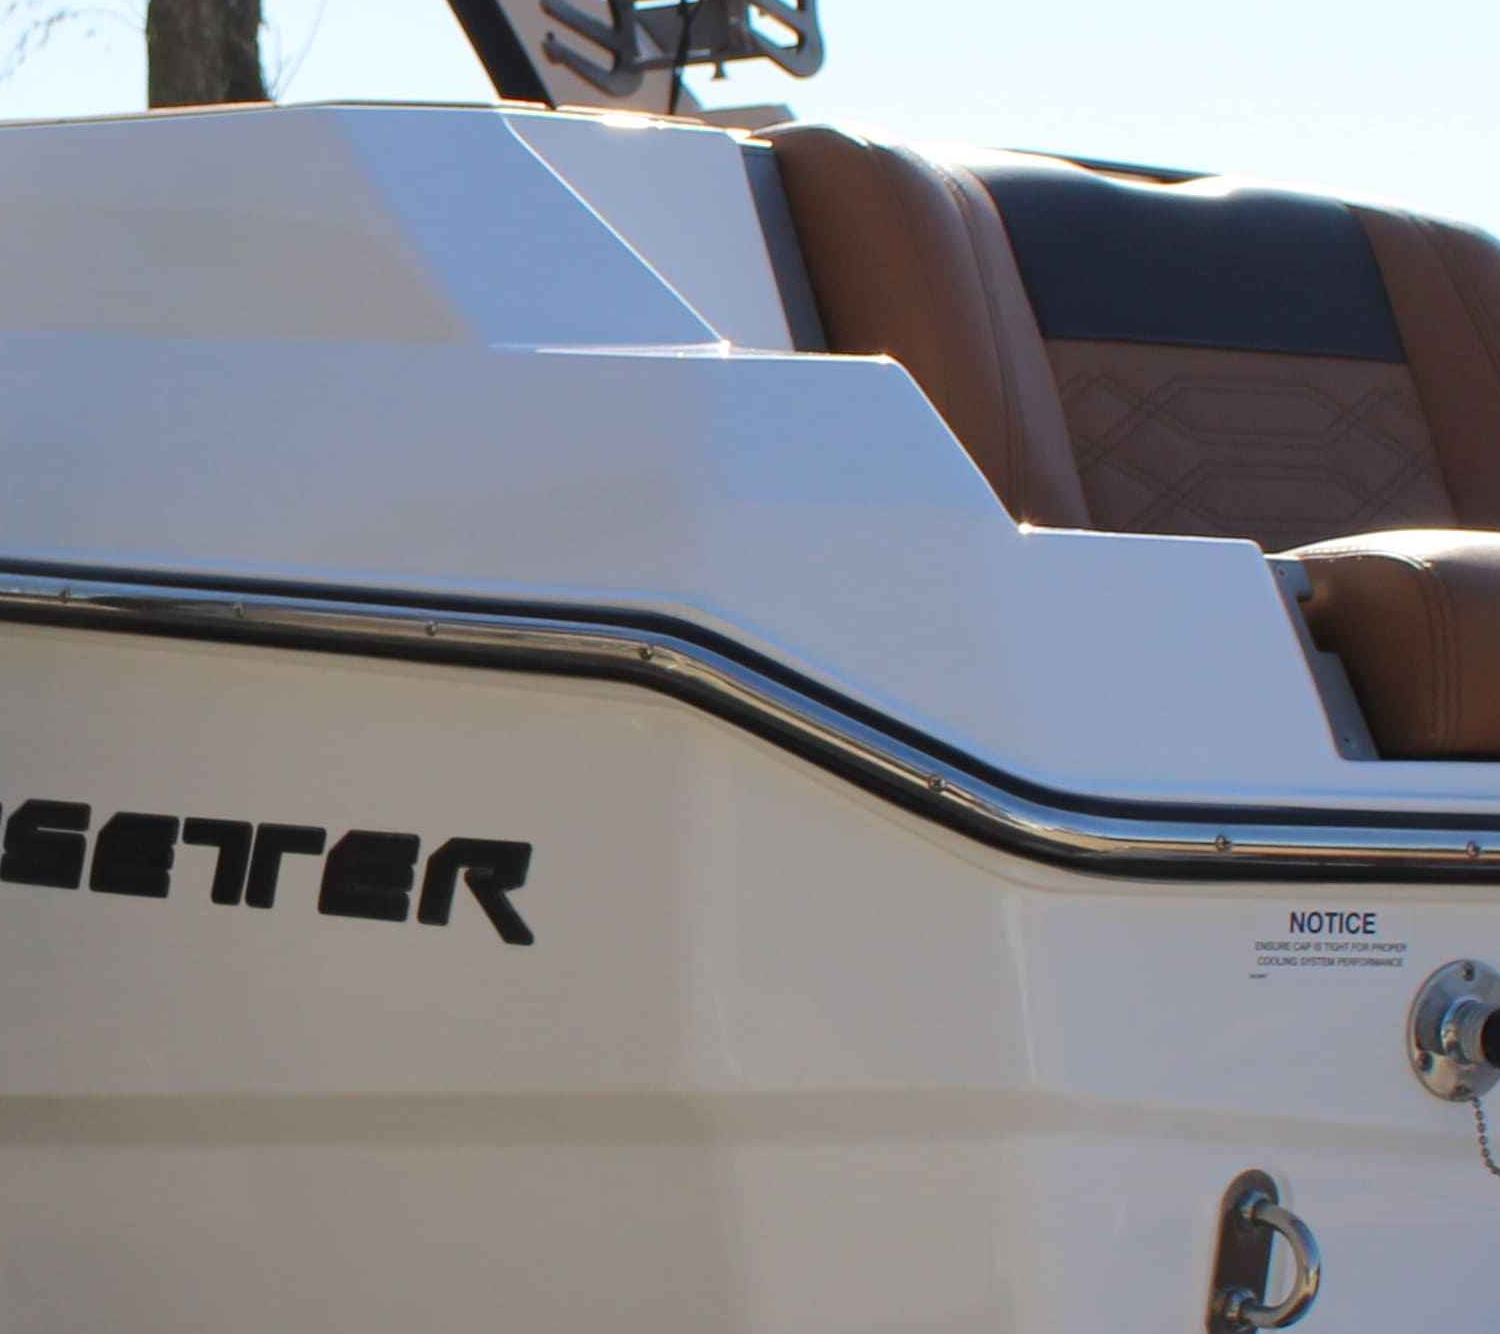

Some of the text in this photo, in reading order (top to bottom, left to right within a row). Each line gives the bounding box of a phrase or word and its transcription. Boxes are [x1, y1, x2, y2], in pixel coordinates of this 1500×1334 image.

[1289, 911, 1376, 934] NOTICE
[1294, 941, 1311, 951] CAP
[1324, 942, 1350, 952] TIGHT
[1372, 942, 1407, 953] PROPER
[1256, 956, 1298, 967] COOLING
